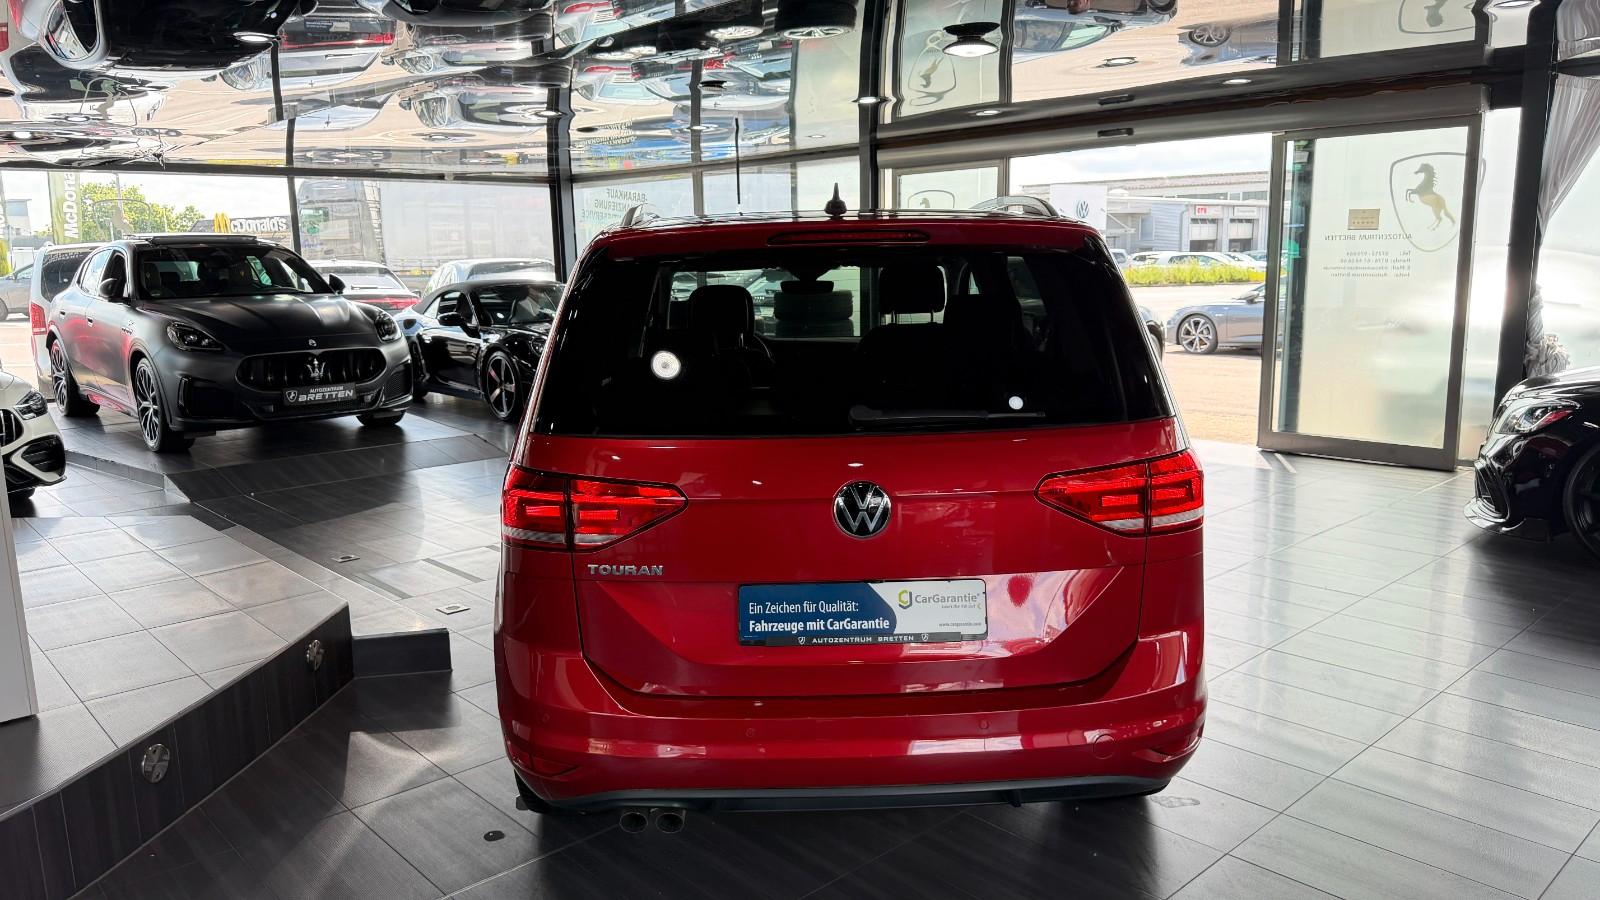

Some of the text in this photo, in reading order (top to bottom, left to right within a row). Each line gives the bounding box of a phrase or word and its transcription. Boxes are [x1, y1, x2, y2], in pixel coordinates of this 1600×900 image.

[298, 389, 354, 402] BRETTEN
[587, 564, 664, 576] TOURAN
[749, 600, 859, 614] Ein Zeichen für Qualität:
[749, 617, 890, 634] Fahrzeuge mit CarGarantie
